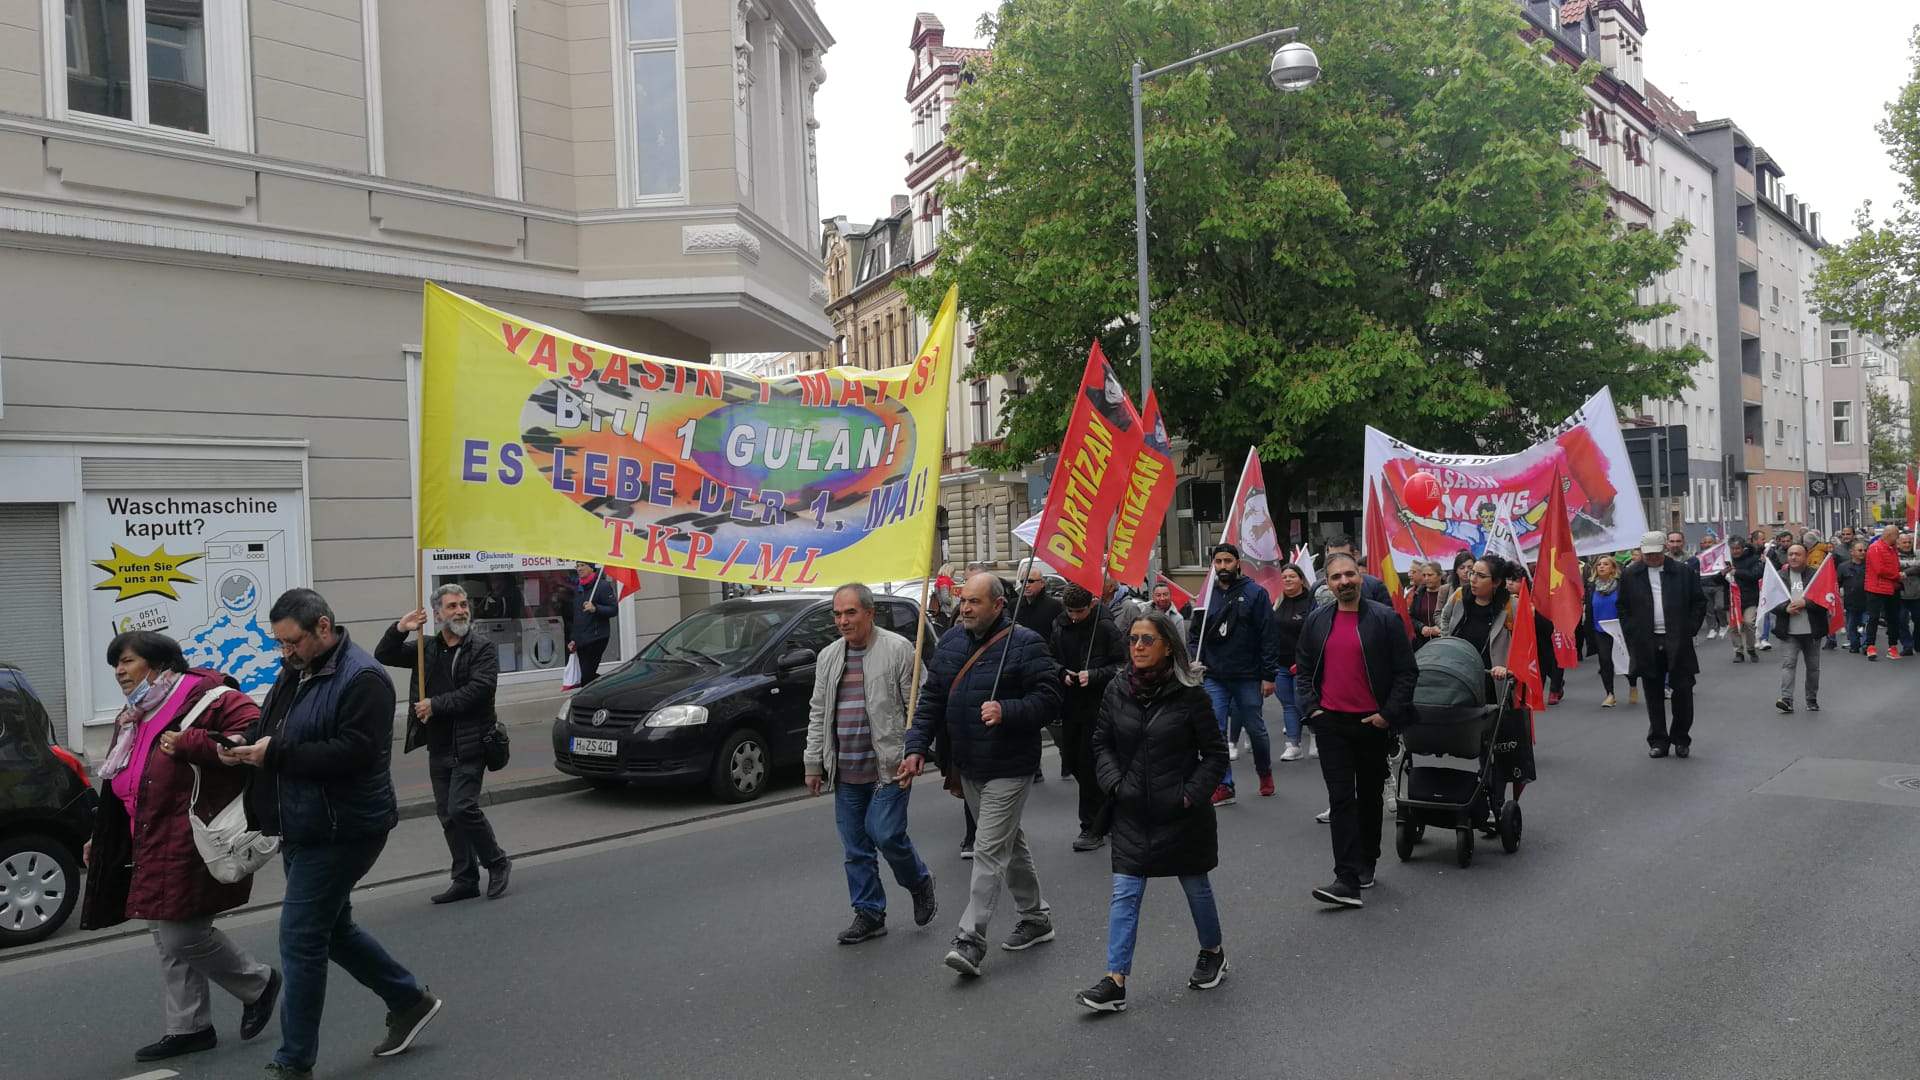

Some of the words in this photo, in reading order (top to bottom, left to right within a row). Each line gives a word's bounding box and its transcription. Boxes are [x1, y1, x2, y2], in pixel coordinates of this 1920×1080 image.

[676, 418, 698, 461] 1
[726, 423, 901, 471] GULAN!
[462, 439, 525, 486] ES
[552, 448, 676, 507] LEBE
[698, 476, 787, 525] DER
[863, 466, 929, 531] MAI!
[107, 497, 278, 515] Waschmaschine
[125, 518, 205, 540] kaputt?
[604, 516, 823, 585] TKP/ML
[432, 553, 471, 561] LIEBHERR
[521, 556, 552, 567] BOSCH
[118, 563, 150, 572] rufen
[154, 562, 172, 572] Sie
[489, 562, 514, 571] gorenje
[124, 574, 145, 583] uns
[150, 574, 164, 583] an
[139, 607, 158, 620] 0511
[598, 741, 613, 753] 401
